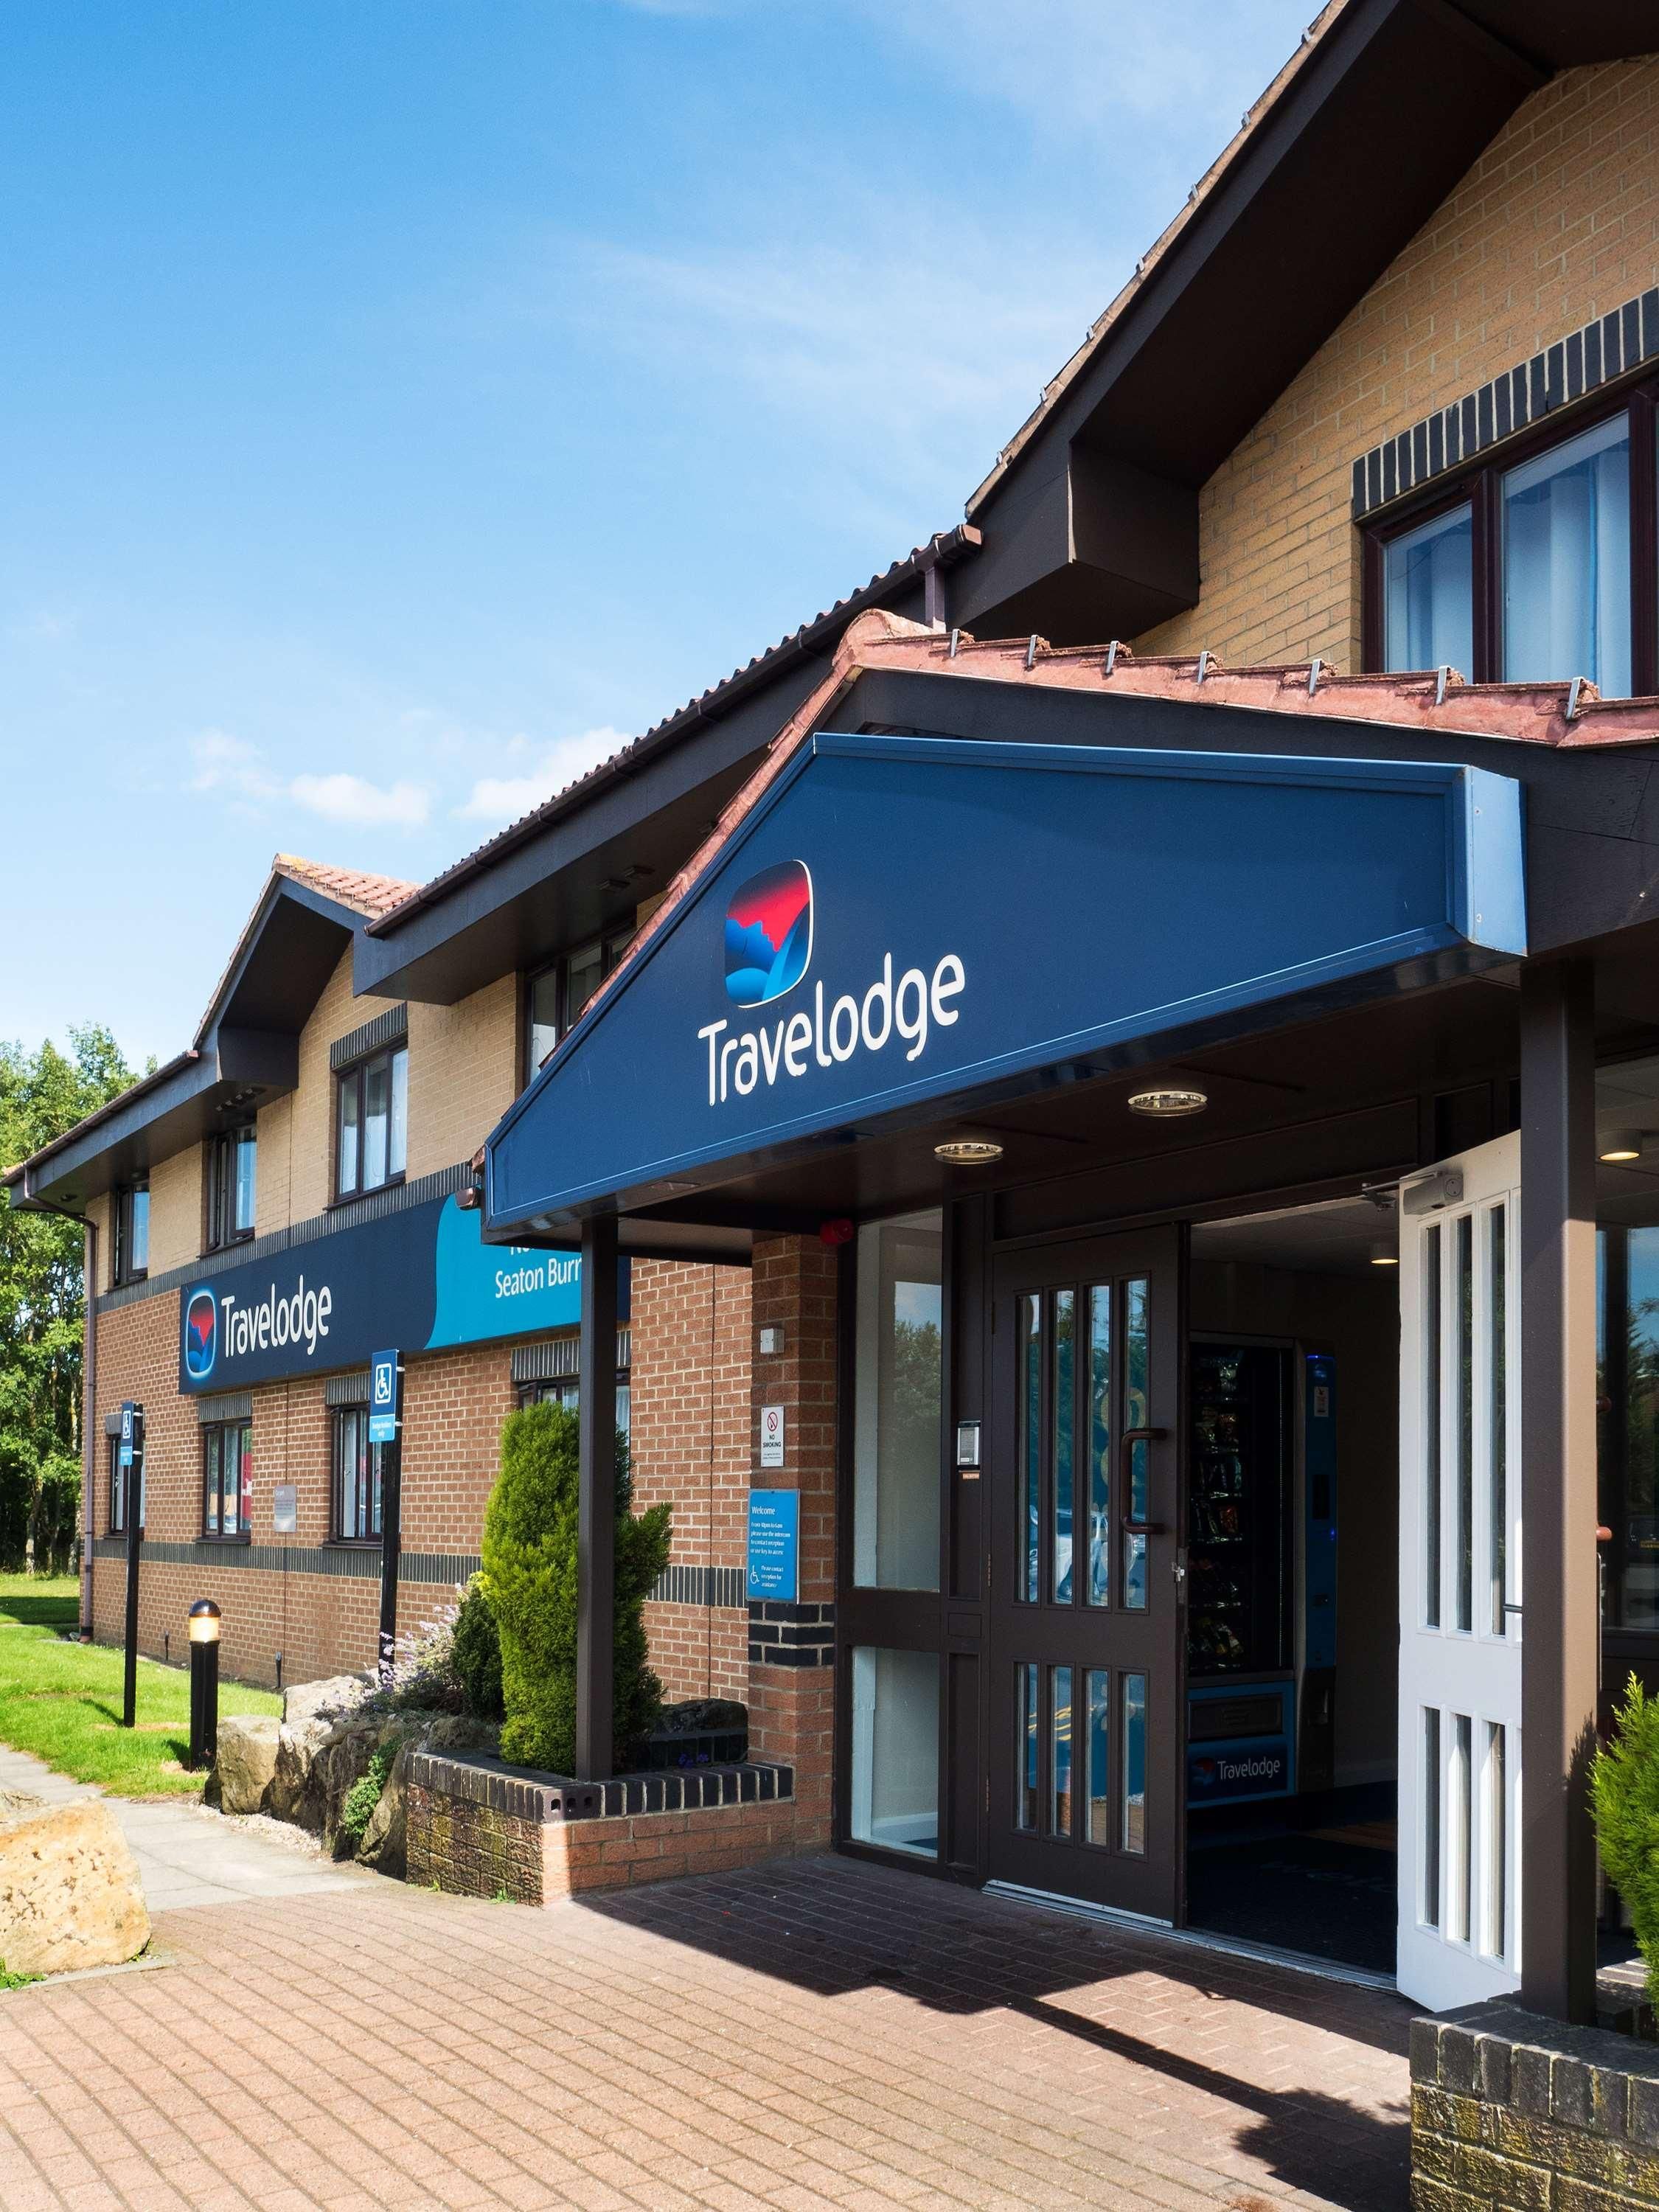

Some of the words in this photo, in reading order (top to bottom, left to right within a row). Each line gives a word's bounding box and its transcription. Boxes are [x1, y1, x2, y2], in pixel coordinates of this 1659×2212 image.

[698, 952, 966, 1107] Travelodge
[495, 1267, 543, 1298] Seaton
[221, 1274, 332, 1358] Travelodge
[751, 1506, 776, 1515] Welcome
[1217, 1756, 1281, 1781] Travelodge
